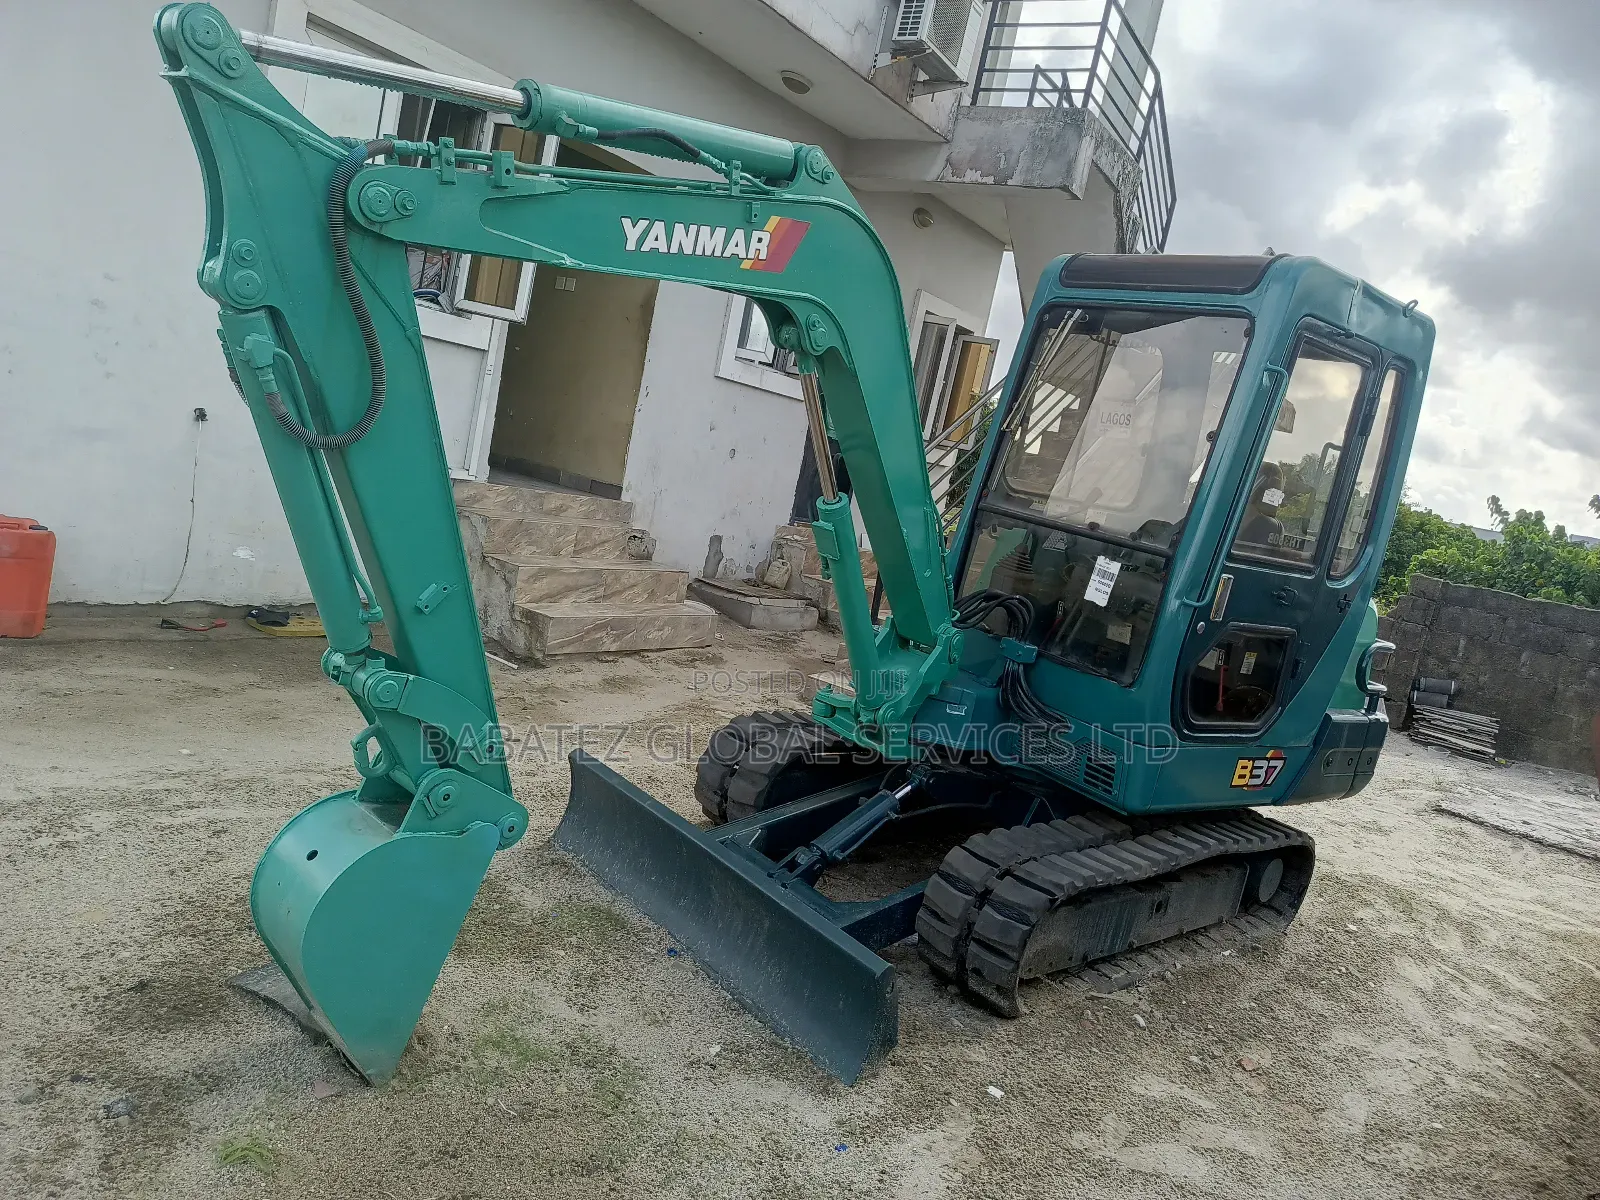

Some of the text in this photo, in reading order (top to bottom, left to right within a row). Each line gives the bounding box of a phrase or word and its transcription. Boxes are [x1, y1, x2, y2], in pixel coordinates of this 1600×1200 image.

[620, 216, 771, 260] YANMAR
[1100, 412, 1132, 426] LAGOS
[1230, 757, 1287, 788] B37
